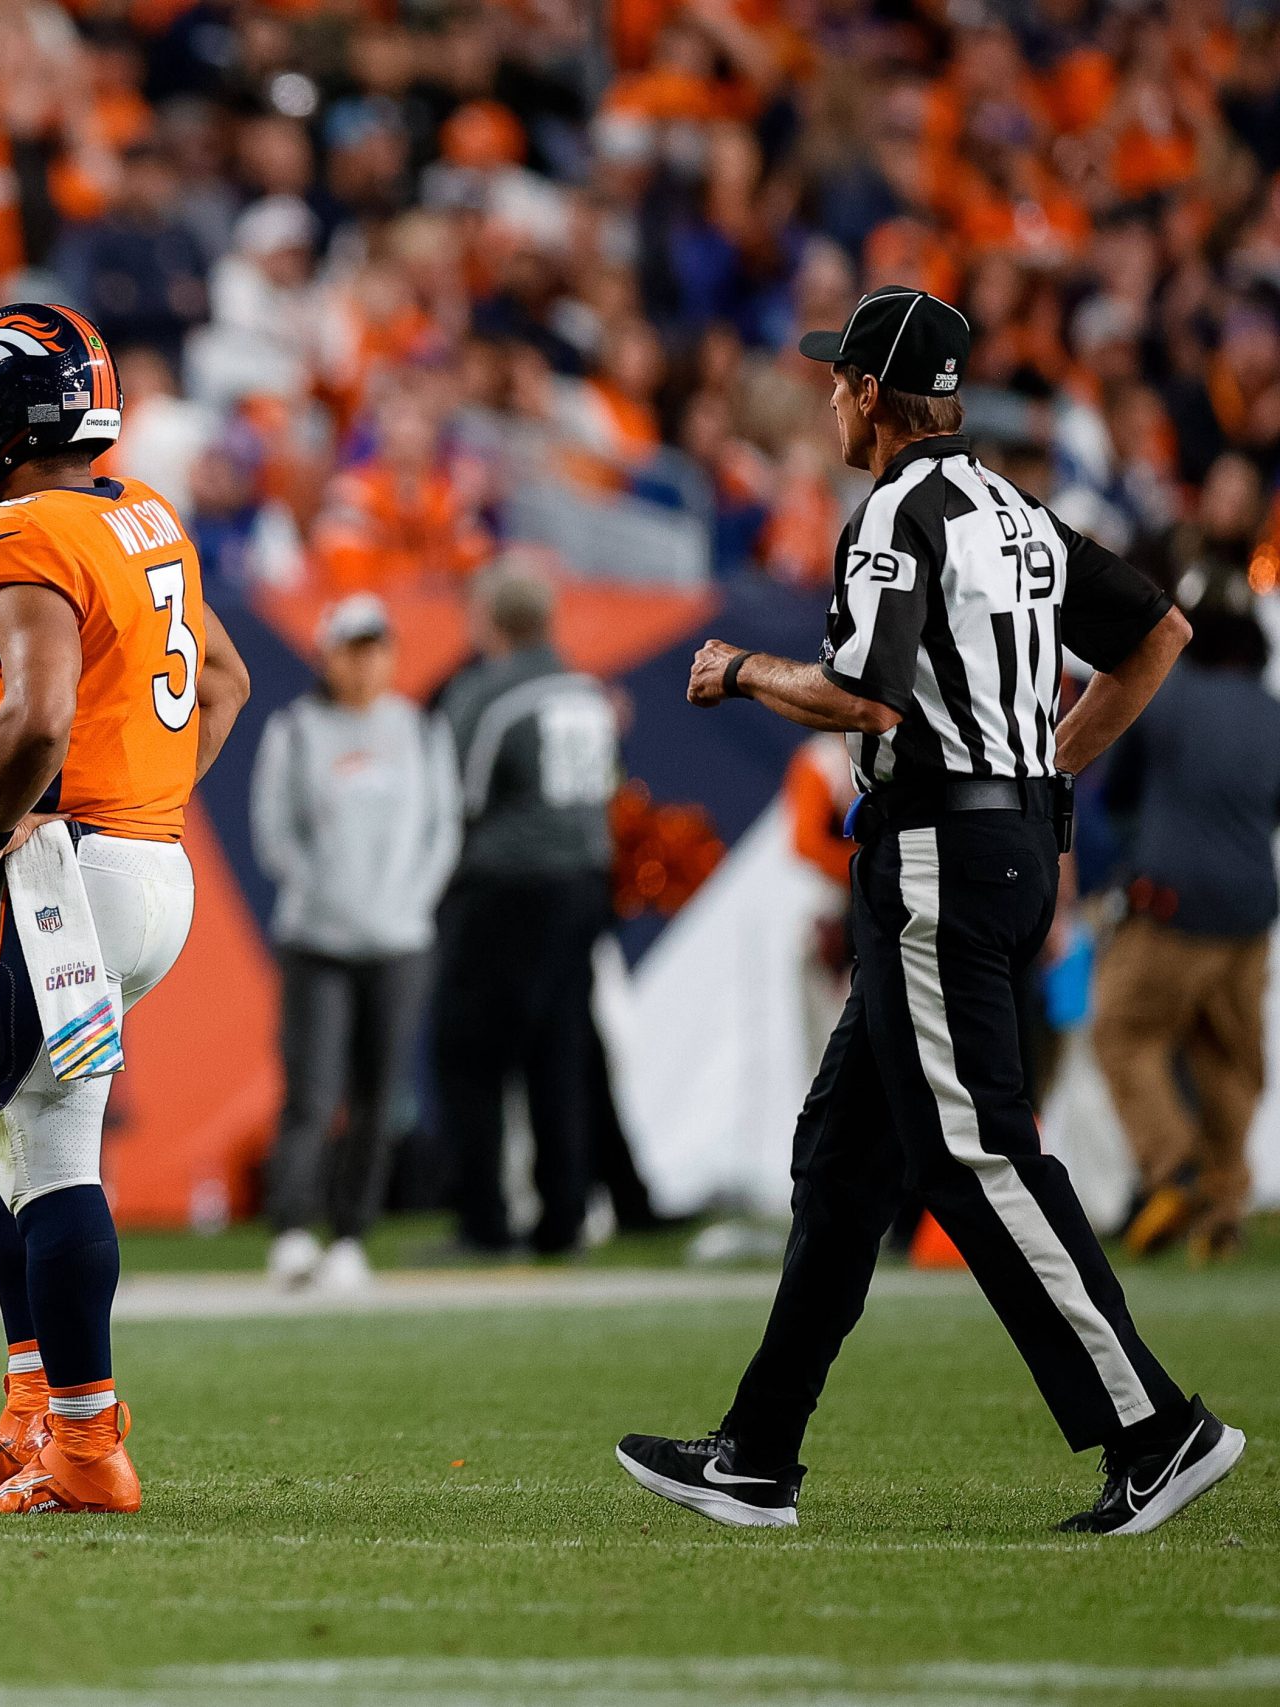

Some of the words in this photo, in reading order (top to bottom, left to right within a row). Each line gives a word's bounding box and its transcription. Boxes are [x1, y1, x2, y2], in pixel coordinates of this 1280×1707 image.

[86, 418, 110, 427] CHOOSE
[101, 499, 183, 556] WILSON
[996, 507, 1033, 541] DJ
[847, 550, 900, 582] 79
[1000, 541, 1055, 603] 79
[144, 558, 199, 732] 3
[40, 917, 60, 931] NFL
[45, 965, 96, 992] CATCH
[50, 960, 88, 975] CRUCIAL
